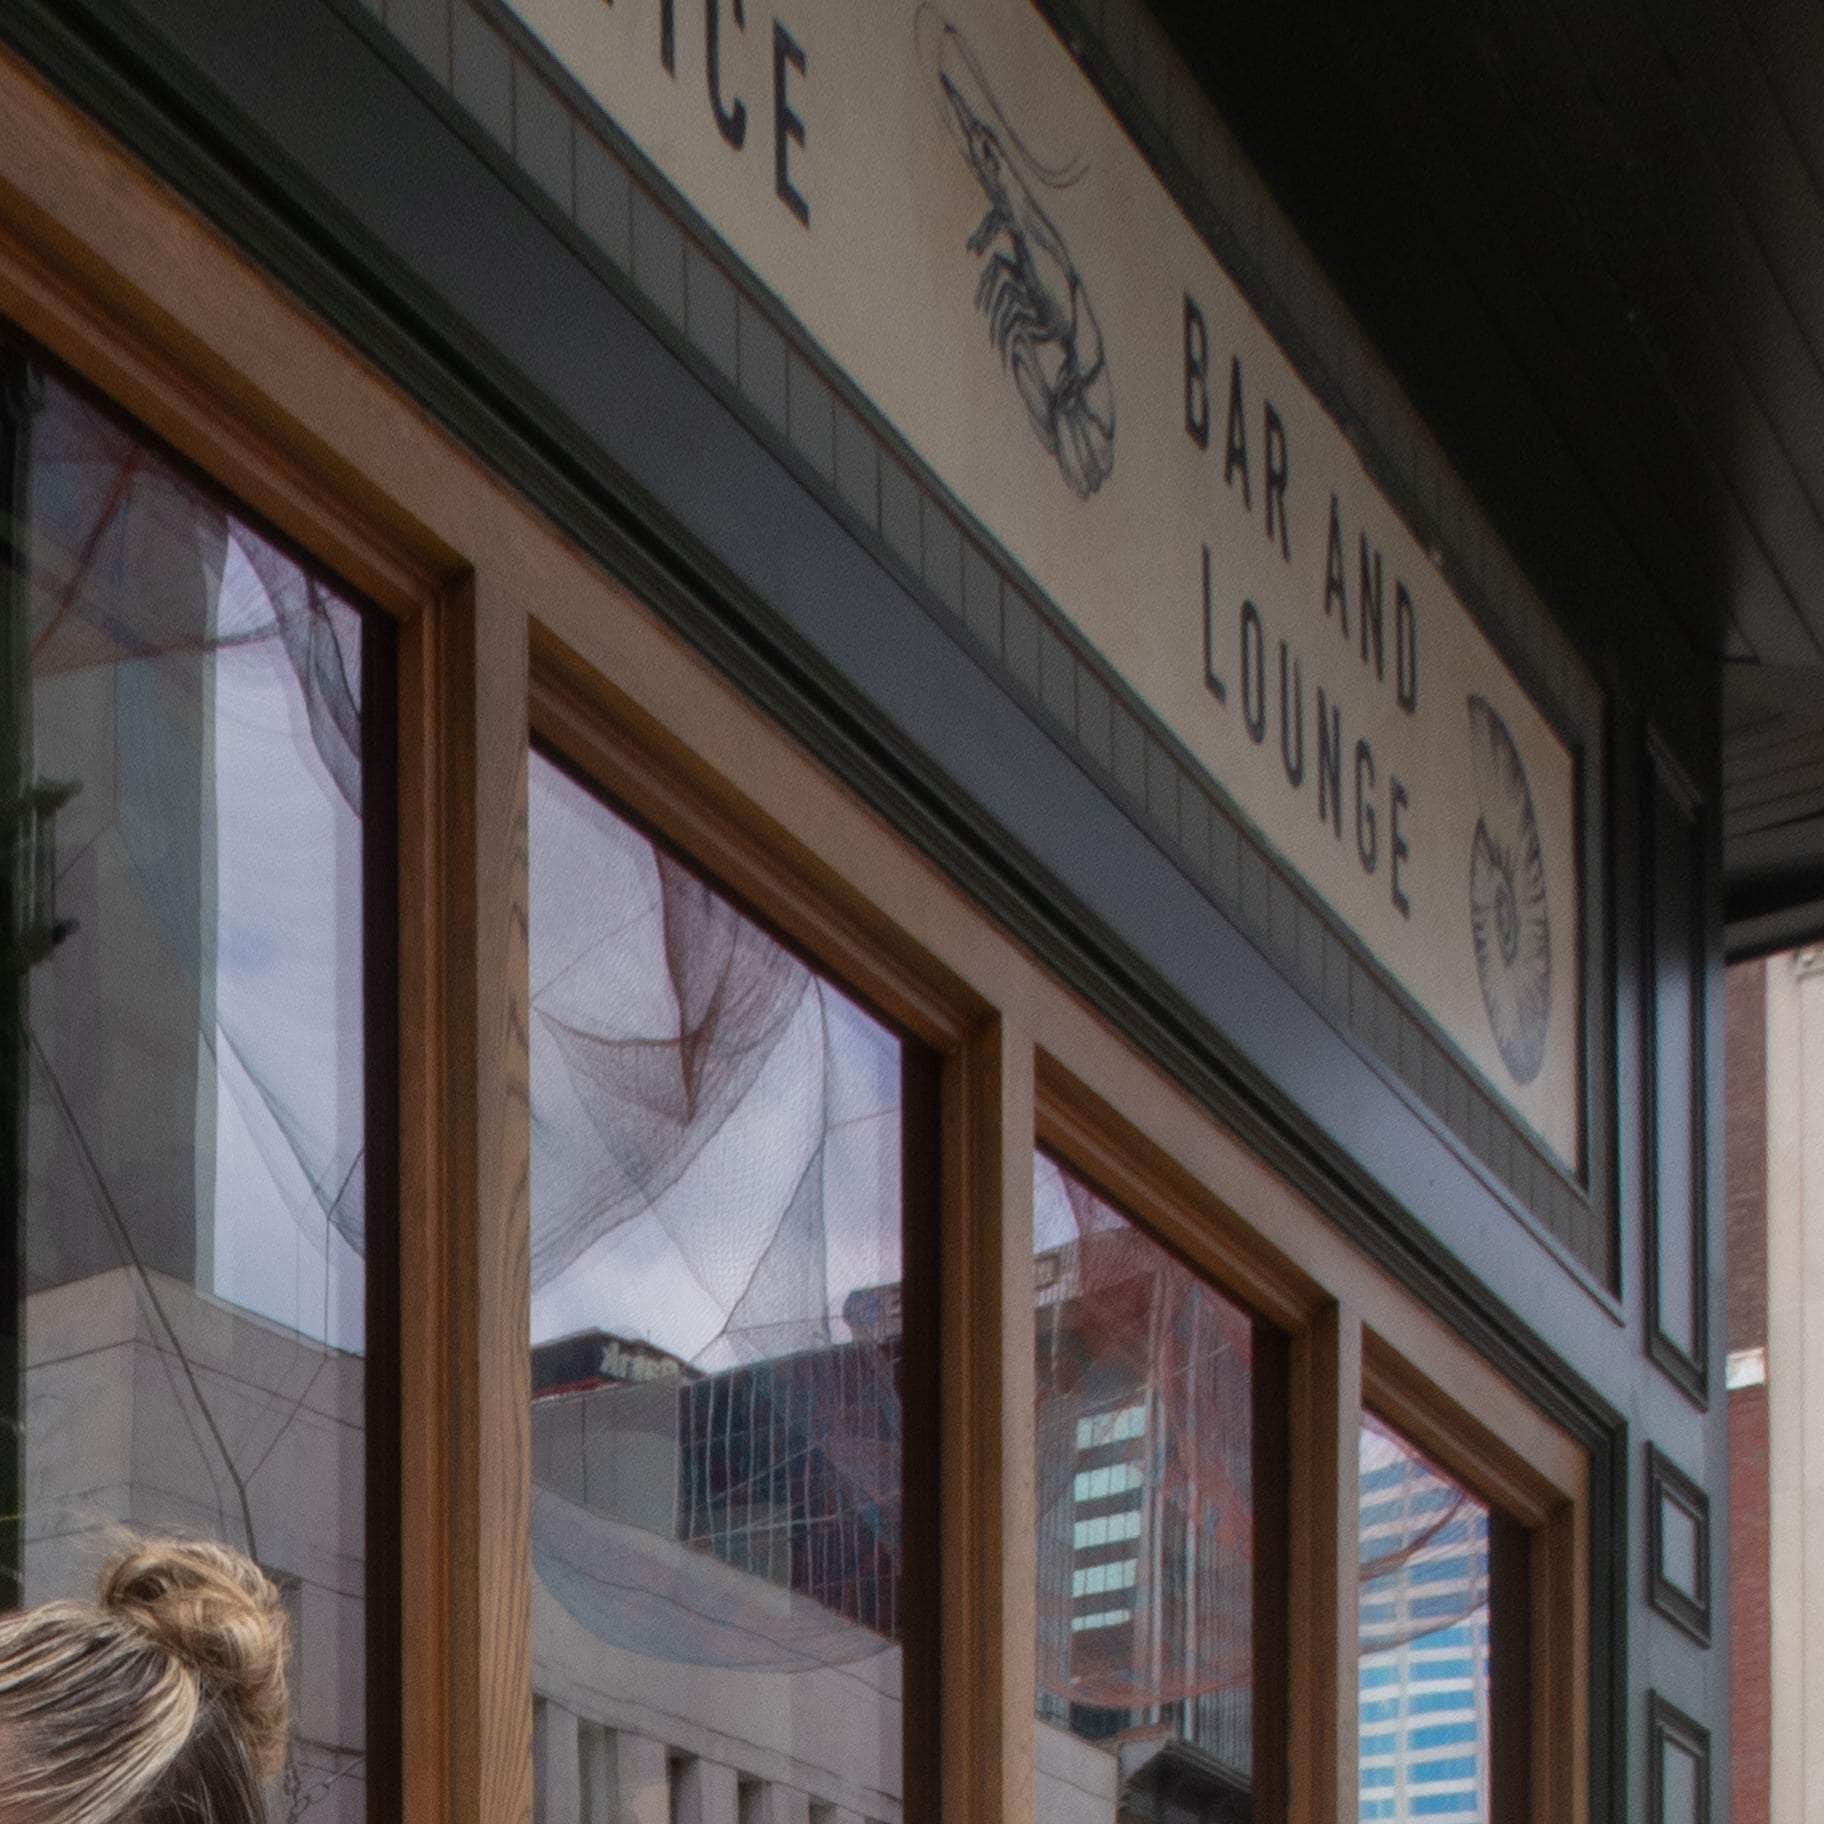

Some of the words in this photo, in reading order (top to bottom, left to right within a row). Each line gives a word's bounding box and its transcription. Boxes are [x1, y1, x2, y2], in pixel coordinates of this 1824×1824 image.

[1182, 290, 1290, 564] BAR
[1322, 493, 1417, 716] AND
[1201, 541, 1411, 920] LOUNGE
